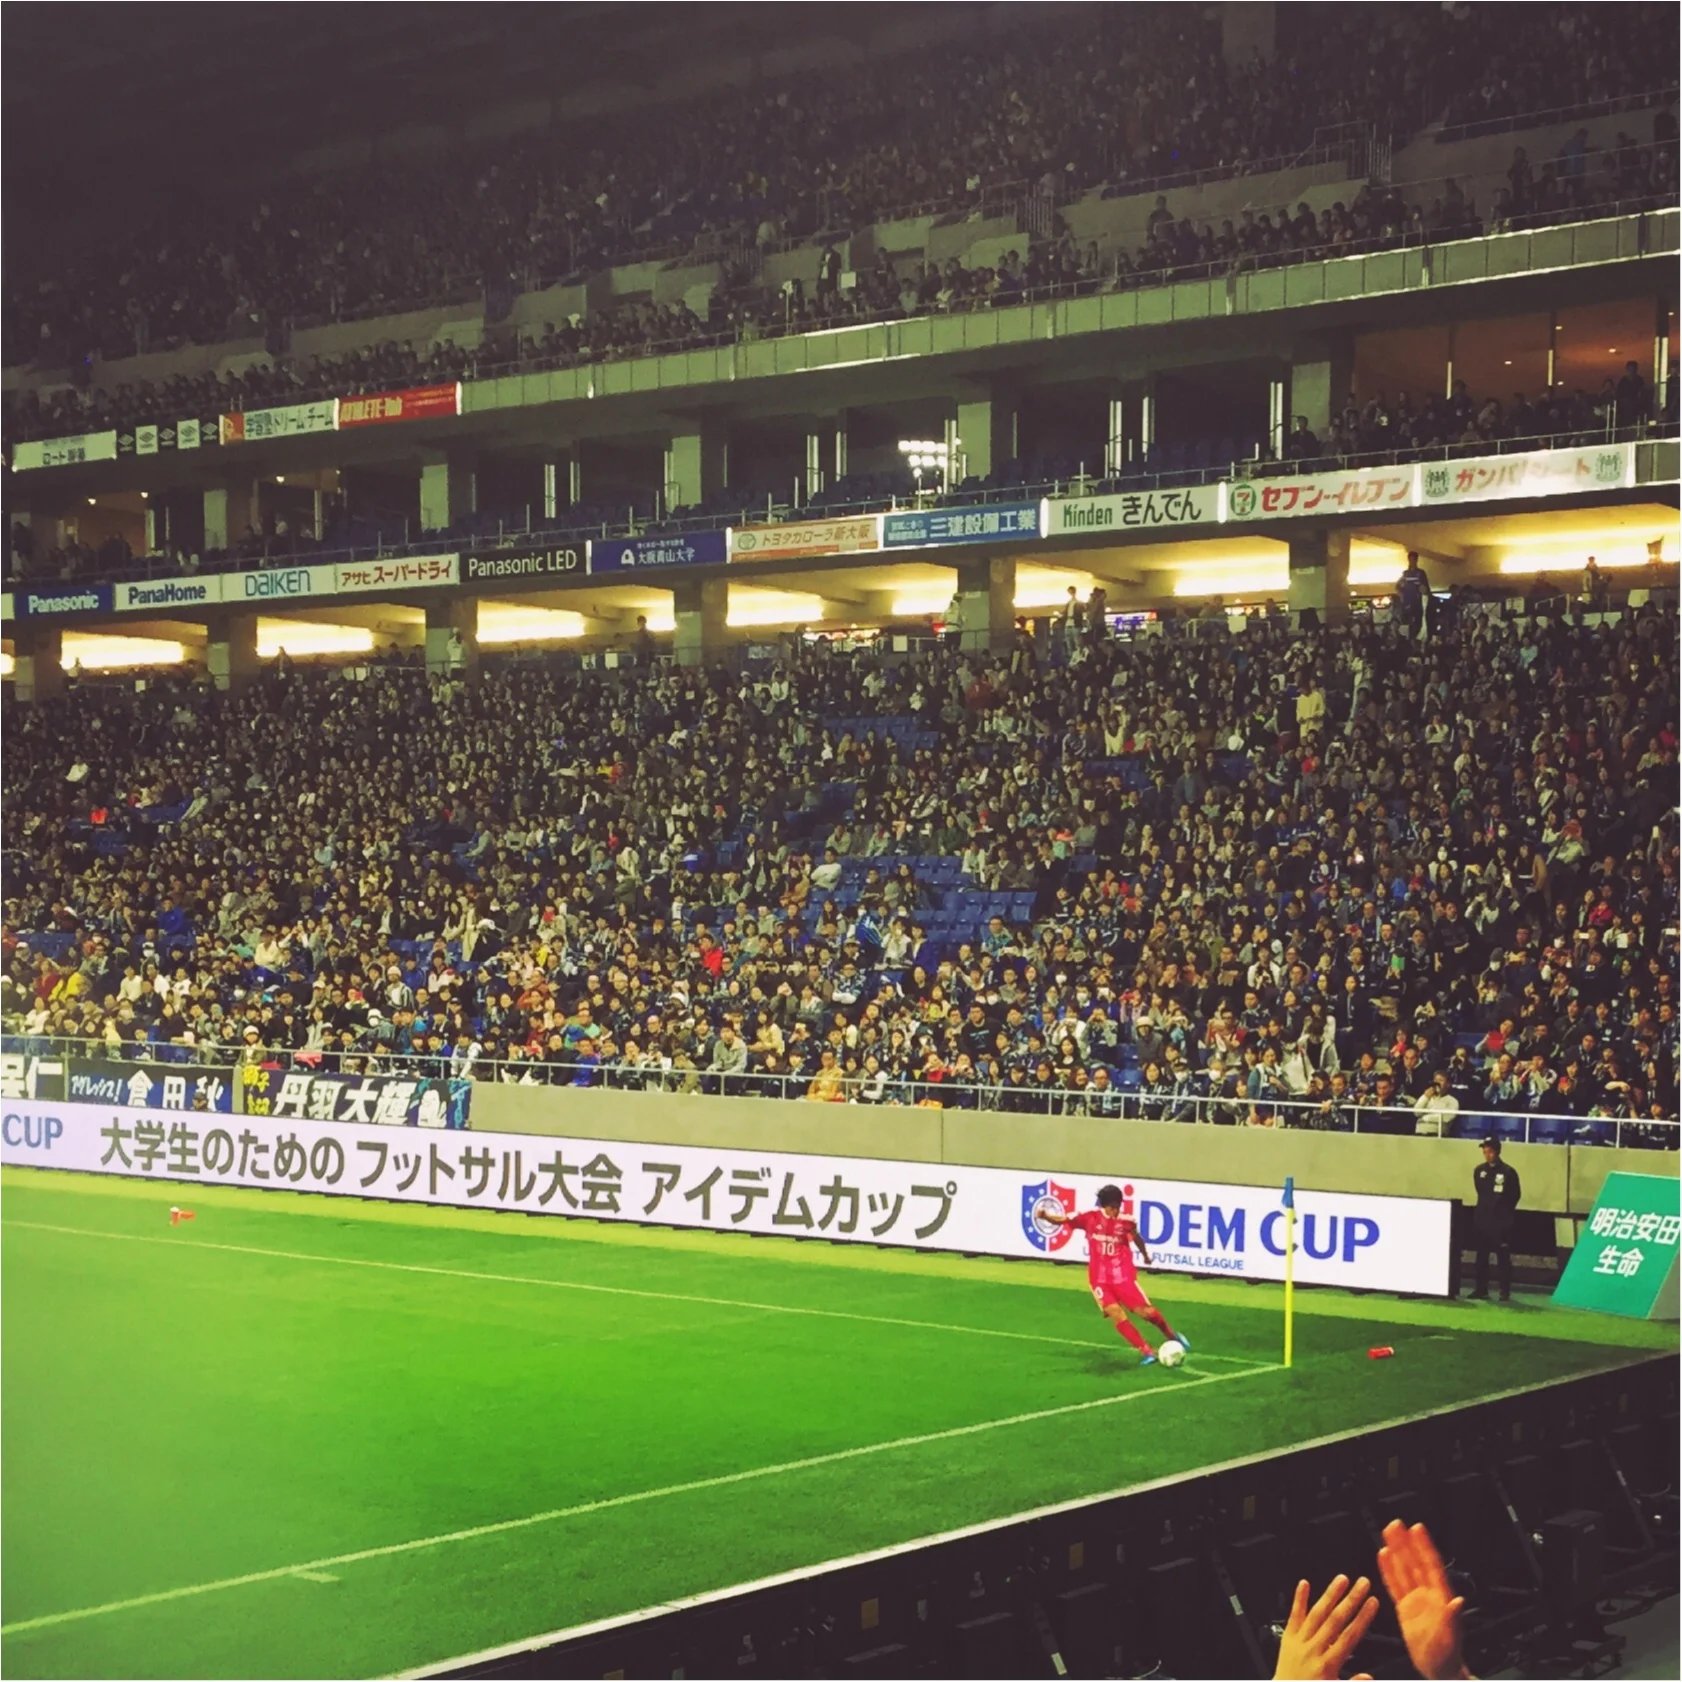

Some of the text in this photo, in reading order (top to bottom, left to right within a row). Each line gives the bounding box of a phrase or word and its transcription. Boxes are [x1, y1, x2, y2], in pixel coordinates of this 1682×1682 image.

[930, 509, 1036, 539] 三建設備工業
[1063, 491, 1201, 528] Kinden きんでん
[762, 524, 872, 546] トヨタカローラ新大阪
[341, 560, 452, 587] アサヒ スーパードライ
[469, 550, 577, 577] Panasonic LED
[28, 590, 99, 614] Panasonic
[129, 583, 207, 605] PanaHome
[272, 1074, 418, 1126] 丹羽大輝
[2, 1113, 63, 1150] CUP
[100, 1117, 957, 1240] 大学生のための フットサル大会 アイデムカップ
[1260, 1210, 1380, 1263] CUP
[1590, 1207, 1681, 1245] 明治安田
[1101, 1241, 1115, 1256] 10
[1152, 1252, 1196, 1267] FUTSAL
[1199, 1258, 1244, 1271] LEAGUE
[1593, 1245, 1645, 1277] 生命
